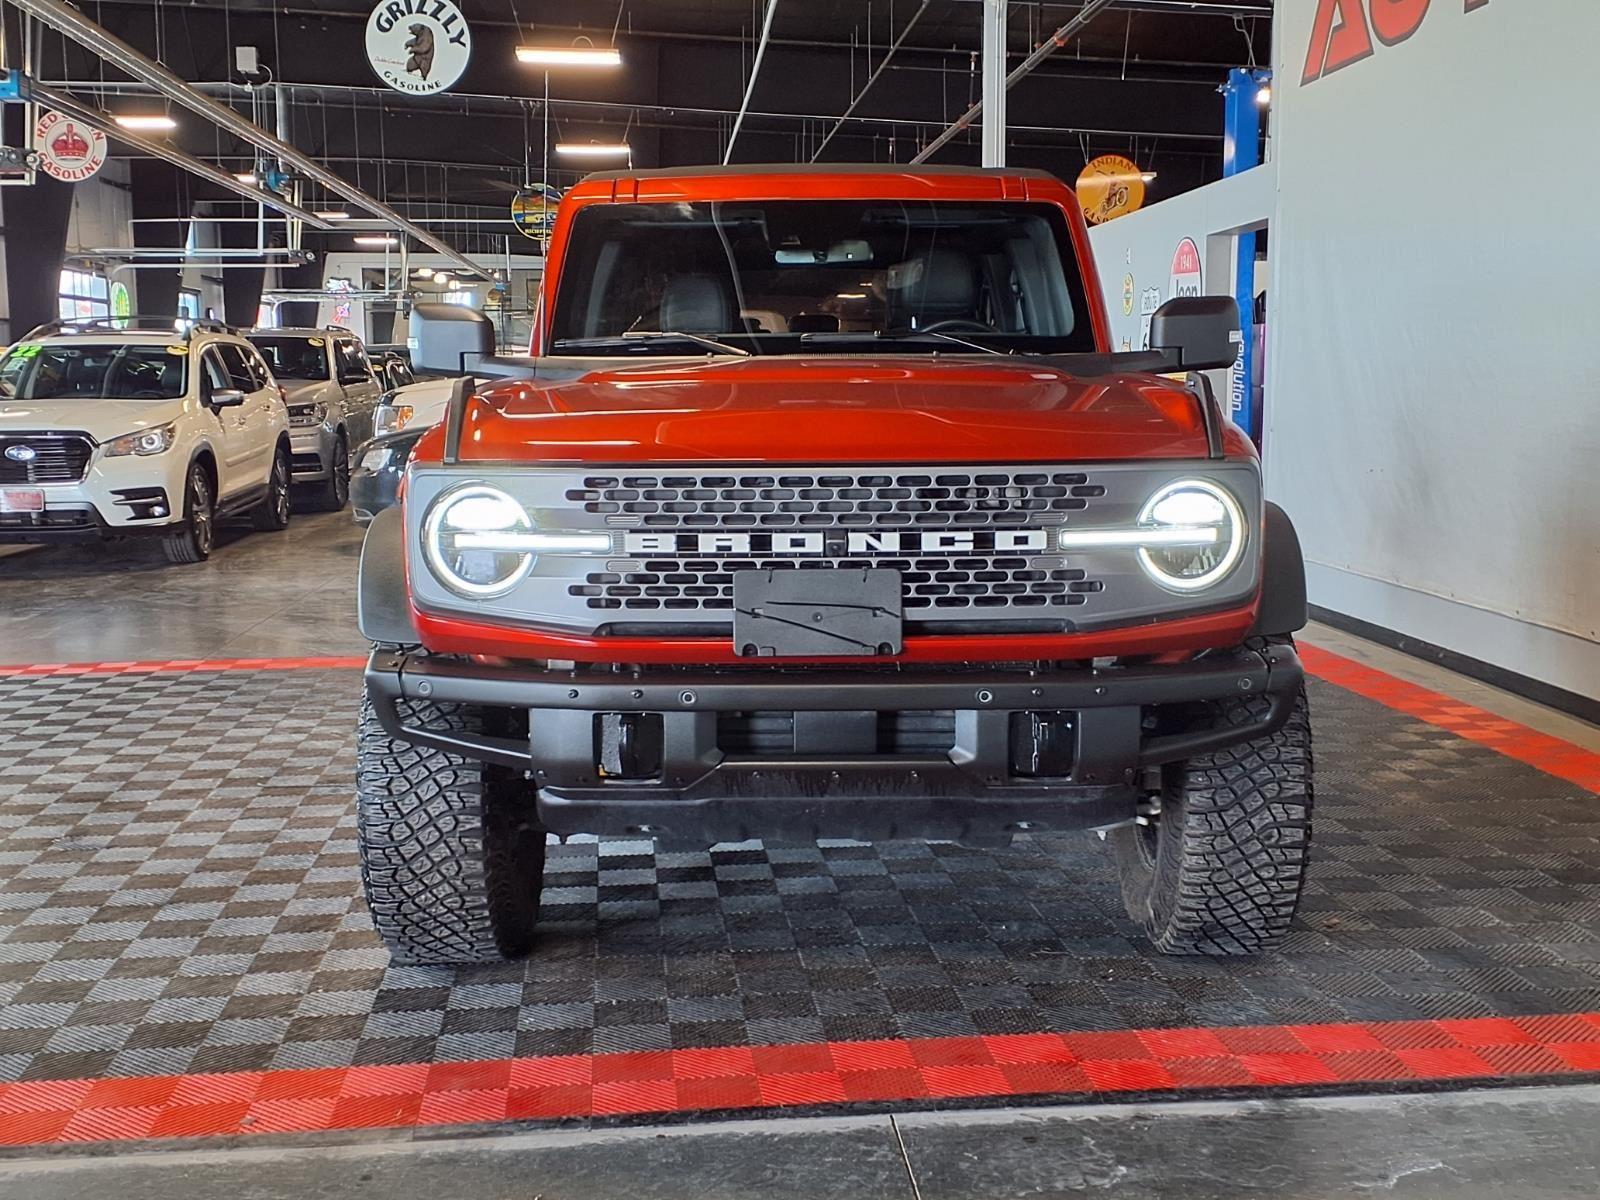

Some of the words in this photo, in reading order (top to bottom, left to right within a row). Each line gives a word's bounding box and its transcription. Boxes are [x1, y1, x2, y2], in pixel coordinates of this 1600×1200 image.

[376, 0, 467, 48] GRIZZLY
[384, 70, 442, 92] GASOLINE
[37, 113, 58, 139] RED
[1092, 157, 1133, 171] INDIAN
[624, 531, 1048, 551] BRONCO
